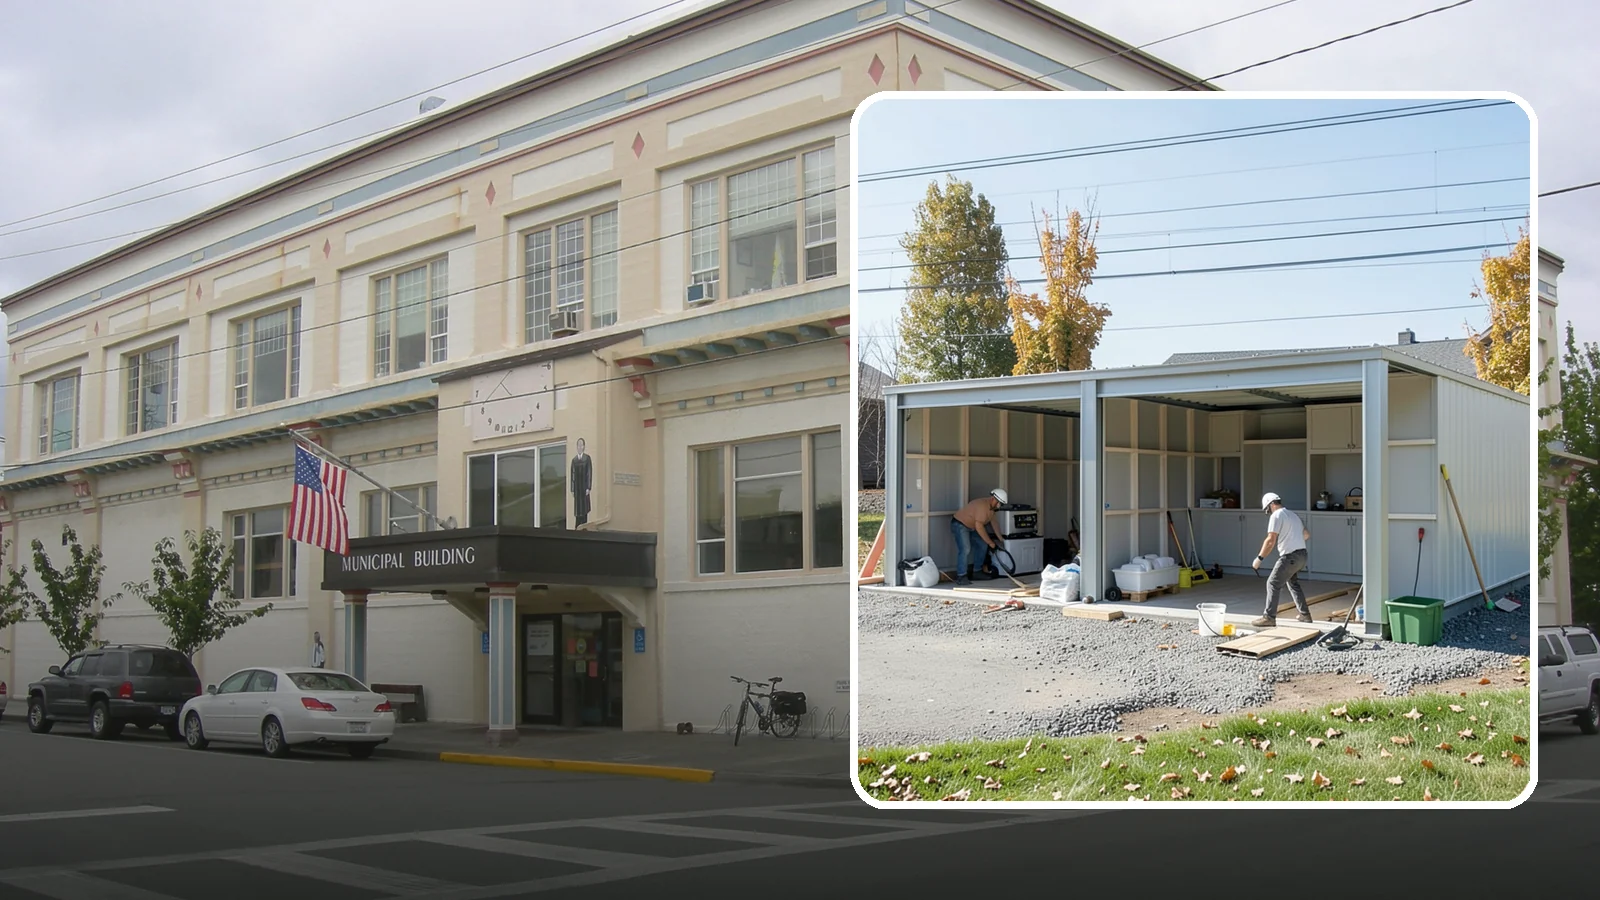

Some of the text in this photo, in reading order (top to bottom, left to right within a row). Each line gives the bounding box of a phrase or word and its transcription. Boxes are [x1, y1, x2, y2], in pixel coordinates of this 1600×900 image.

[546, 362, 552, 370] 6
[475, 390, 479, 398] 7
[536, 402, 540, 410] 4
[480, 407, 485, 415] 8
[488, 417, 492, 425] 9
[528, 414, 533, 422] 3
[494, 423, 500, 432] 10
[501, 425, 506, 433] 11
[507, 425, 513, 433] 12
[521, 420, 525, 428] 2
[342, 546, 475, 572] MUNICIPAL BUILDING
